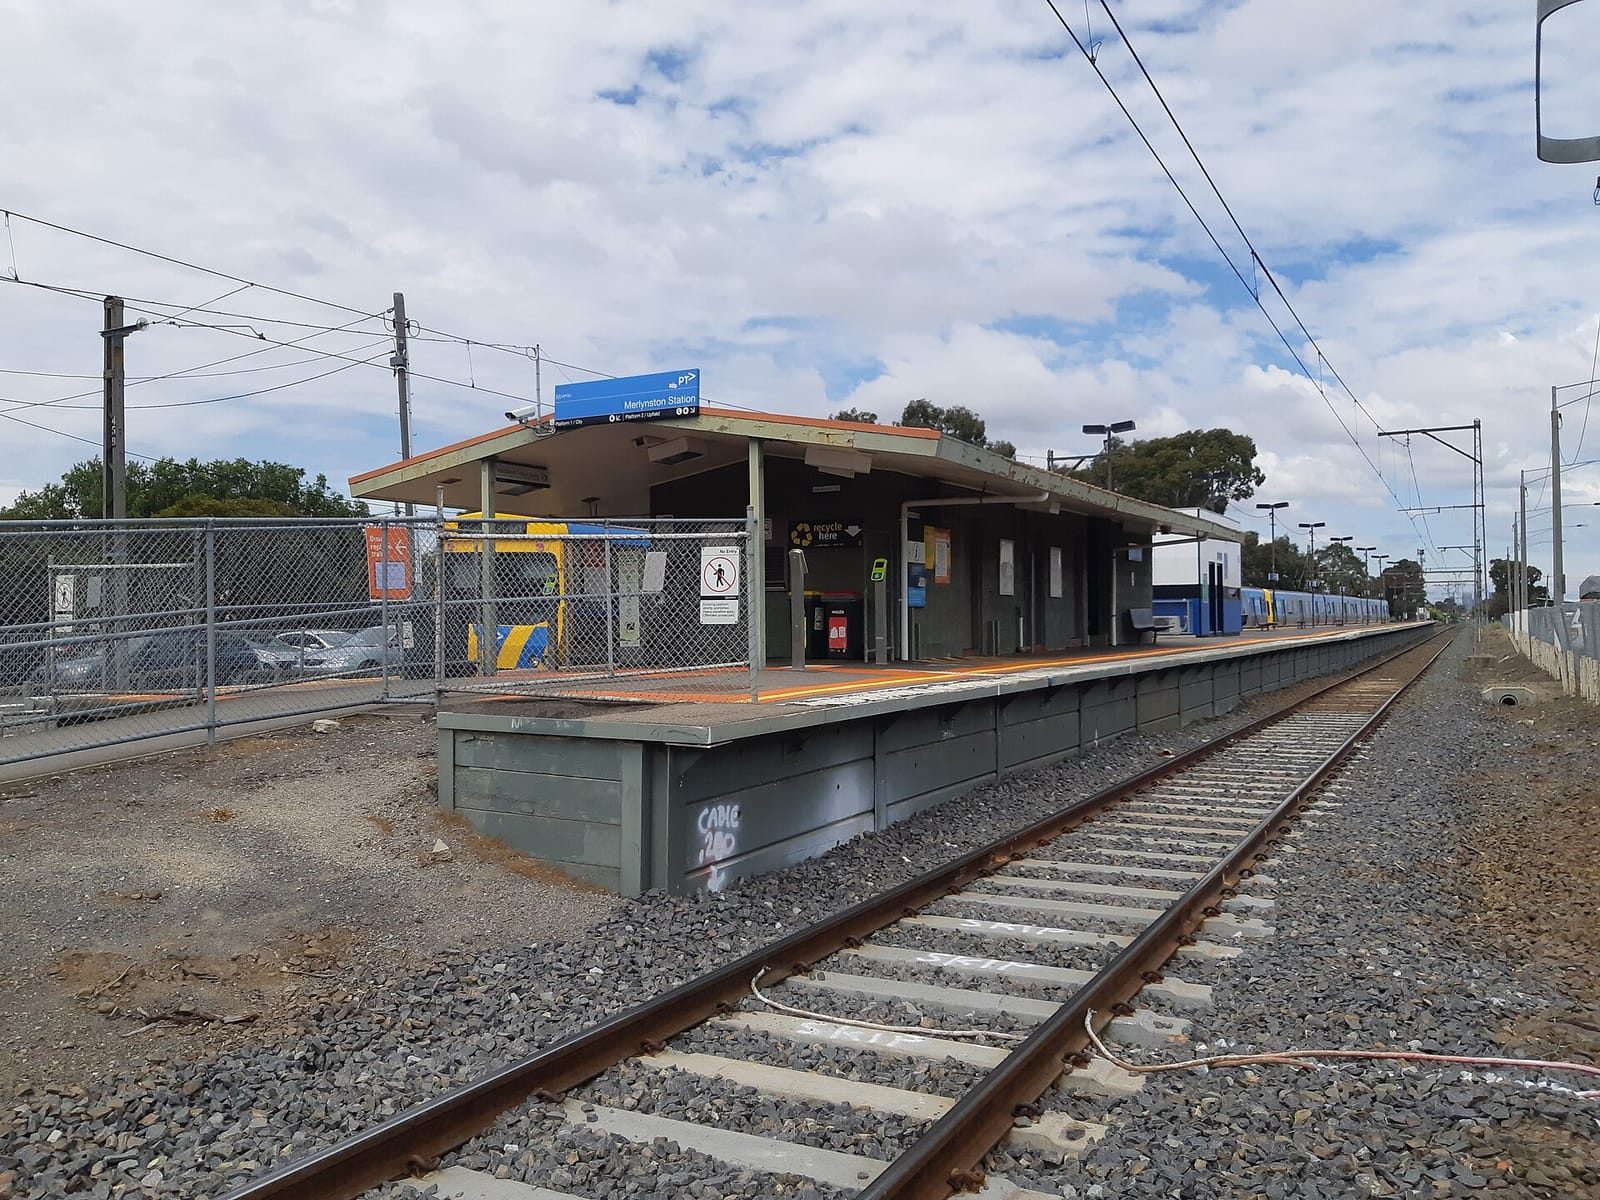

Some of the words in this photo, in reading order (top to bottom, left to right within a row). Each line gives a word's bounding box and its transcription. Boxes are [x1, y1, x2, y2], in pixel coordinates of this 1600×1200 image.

[624, 397, 666, 410] Merlynston
[668, 395, 696, 405] Station
[813, 522, 843, 532] recycle
[818, 532, 838, 540] here
[960, 918, 1066, 935] SKIP
[917, 953, 1035, 971] SKIP
